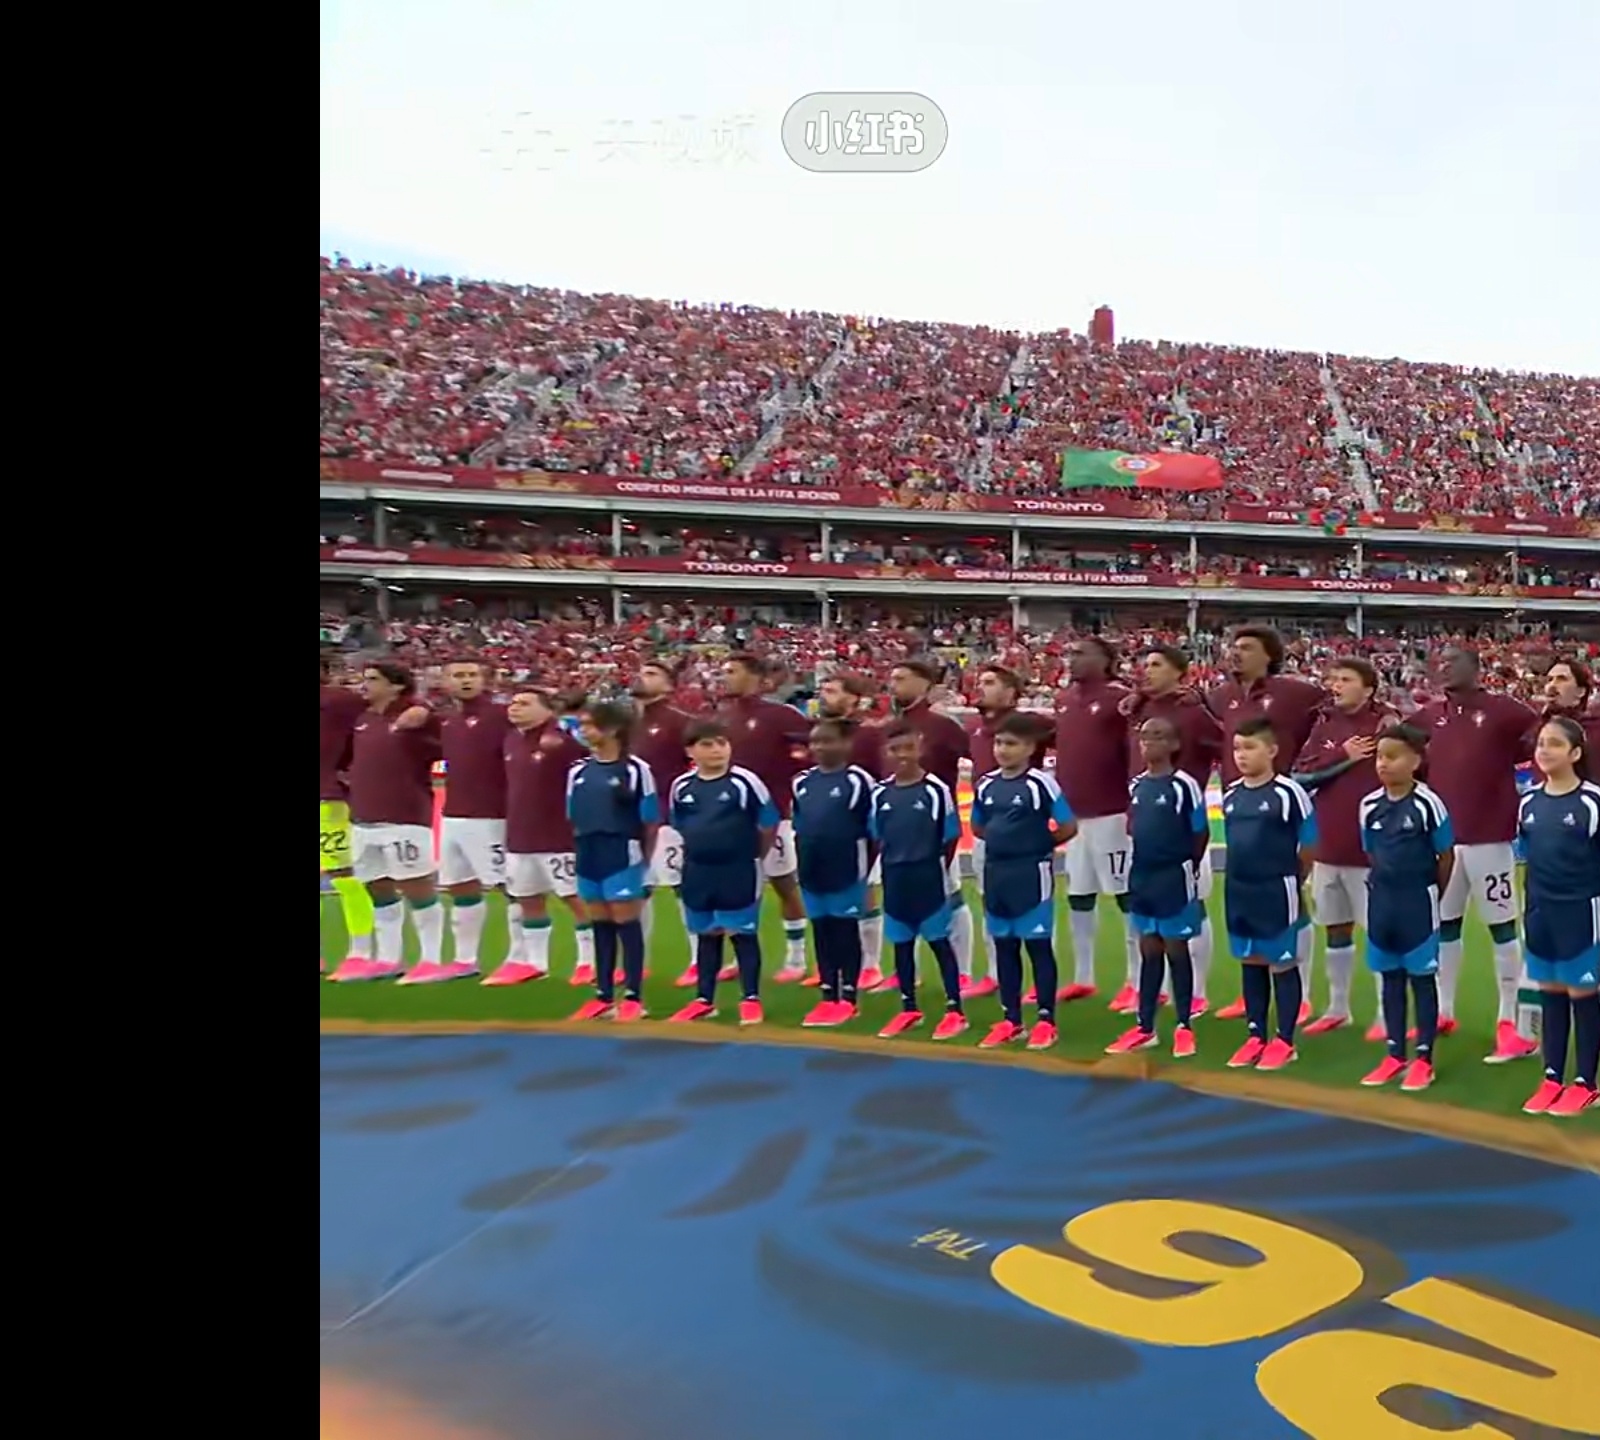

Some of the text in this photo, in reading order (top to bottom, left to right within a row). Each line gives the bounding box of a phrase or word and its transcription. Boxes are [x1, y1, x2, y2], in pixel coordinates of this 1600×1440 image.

[616, 482, 660, 493] COUPE
[661, 483, 681, 494] DU
[683, 485, 729, 496] MONDE
[730, 487, 746, 497] DE
[750, 488, 766, 497] LA
[767, 489, 795, 499] FIFA
[1014, 500, 1105, 512] TORONTO
[683, 562, 789, 573] TORONTO
[1312, 581, 1392, 591] TORONTO
[1108, 850, 1126, 874] 17
[1485, 872, 1511, 901] 25
